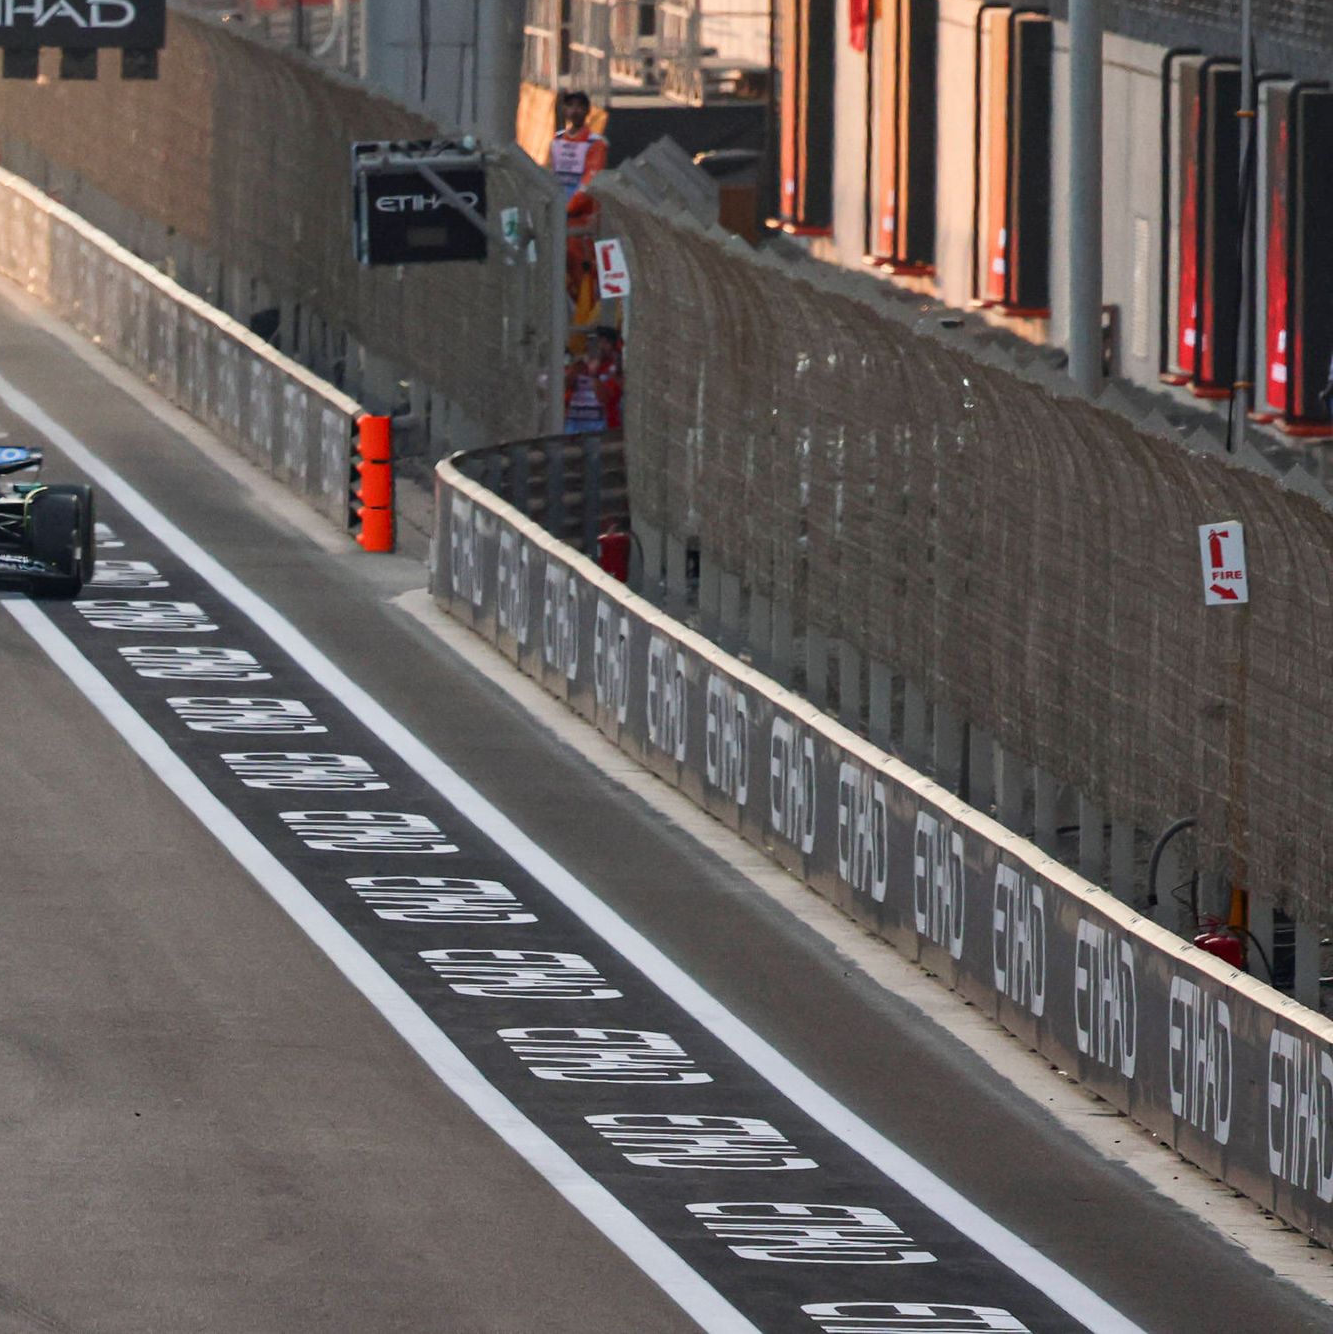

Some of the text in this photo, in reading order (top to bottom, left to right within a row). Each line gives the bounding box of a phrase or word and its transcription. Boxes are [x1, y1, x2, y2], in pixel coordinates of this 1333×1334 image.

[1211, 570, 1243, 581] FIRE
[166, 697, 328, 734] ETIHAD
[219, 752, 391, 791] ETIHAD
[770, 716, 816, 854] ETIHAD
[278, 811, 461, 853] ETIHAD
[838, 762, 888, 902] ETIHAD
[345, 876, 539, 924] ETIHAD
[914, 810, 966, 960] ETIHAD
[993, 863, 1046, 1016] ETIHAD
[418, 949, 624, 1000] ETIHAD
[1075, 919, 1137, 1079] ETIHAD
[496, 1027, 715, 1084] ETIHAD
[1169, 976, 1233, 1145] ETIHAD
[584, 1114, 821, 1170] ETIHAD
[1268, 1029, 1333, 1204] ETIHAD
[685, 1202, 938, 1265] ETIHAD
